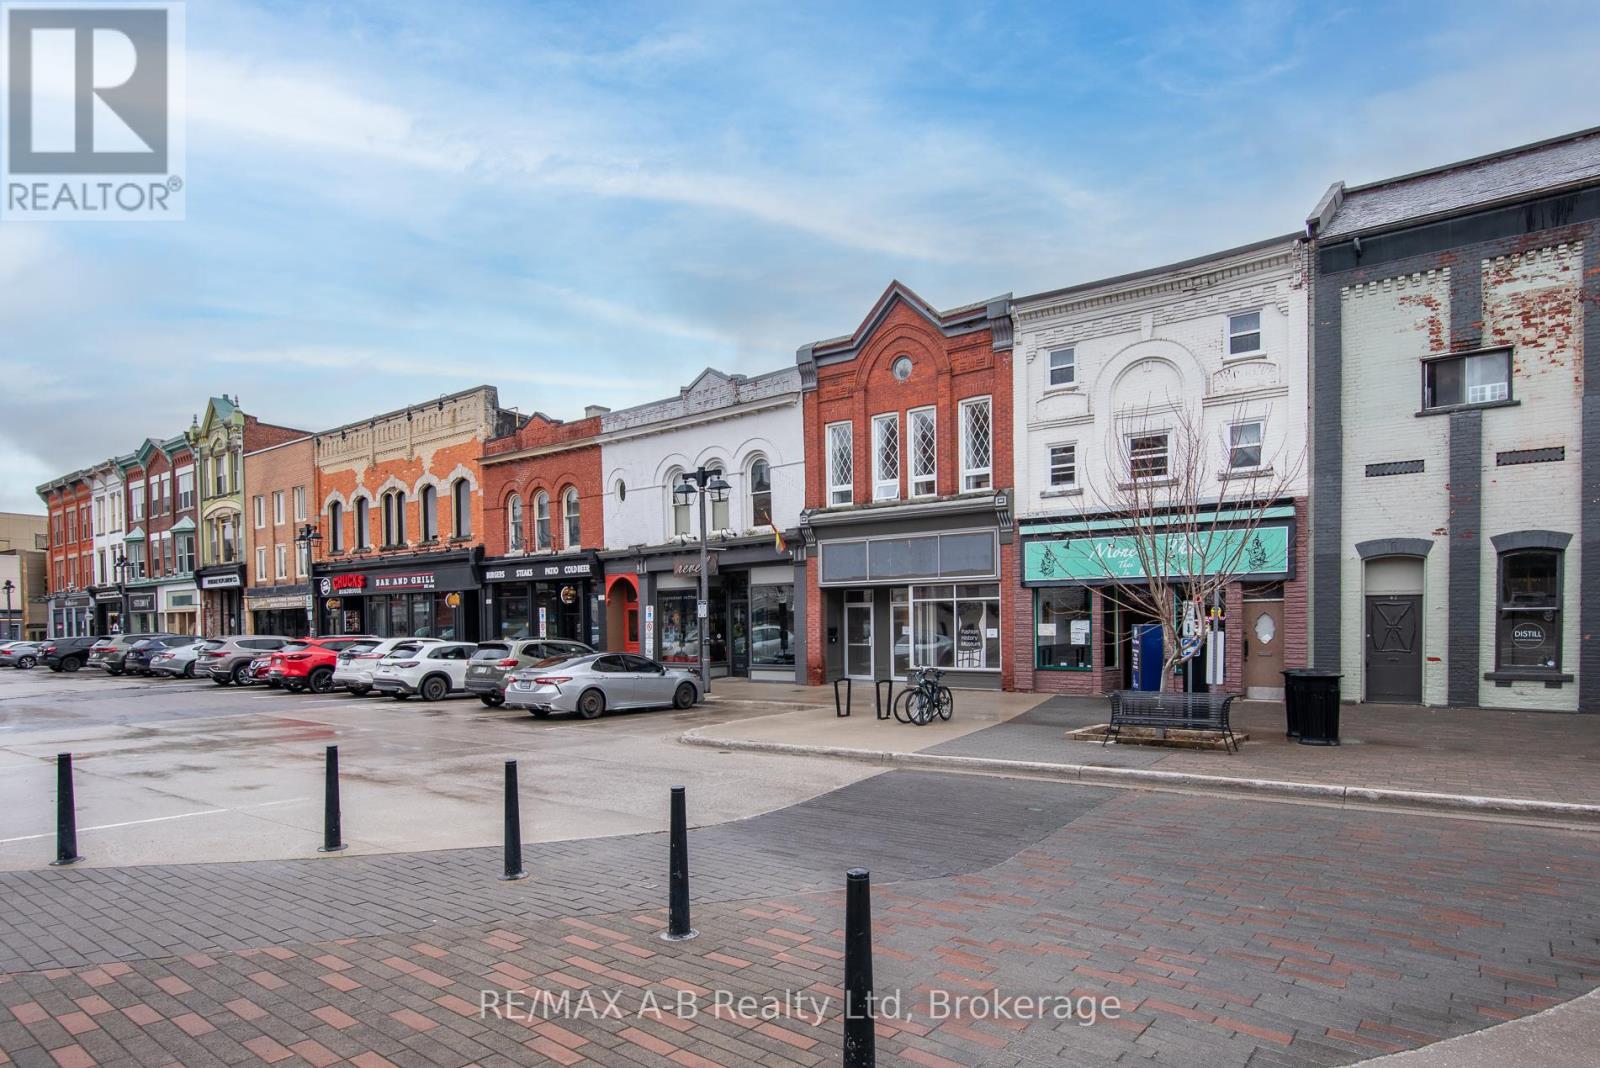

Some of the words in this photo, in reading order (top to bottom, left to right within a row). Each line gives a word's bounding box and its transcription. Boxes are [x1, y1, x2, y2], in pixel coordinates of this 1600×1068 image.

[486, 570, 505, 579] BURGERS
[516, 568, 533, 577] STEAKS
[545, 567, 559, 575] PATIO
[564, 565, 578, 574] COLD
[578, 564, 591, 573] BEER
[376, 578, 391, 587] BAR
[392, 577, 408, 585] AND
[411, 575, 435, 584] GRILL
[1514, 630, 1542, 638] DISTILL
